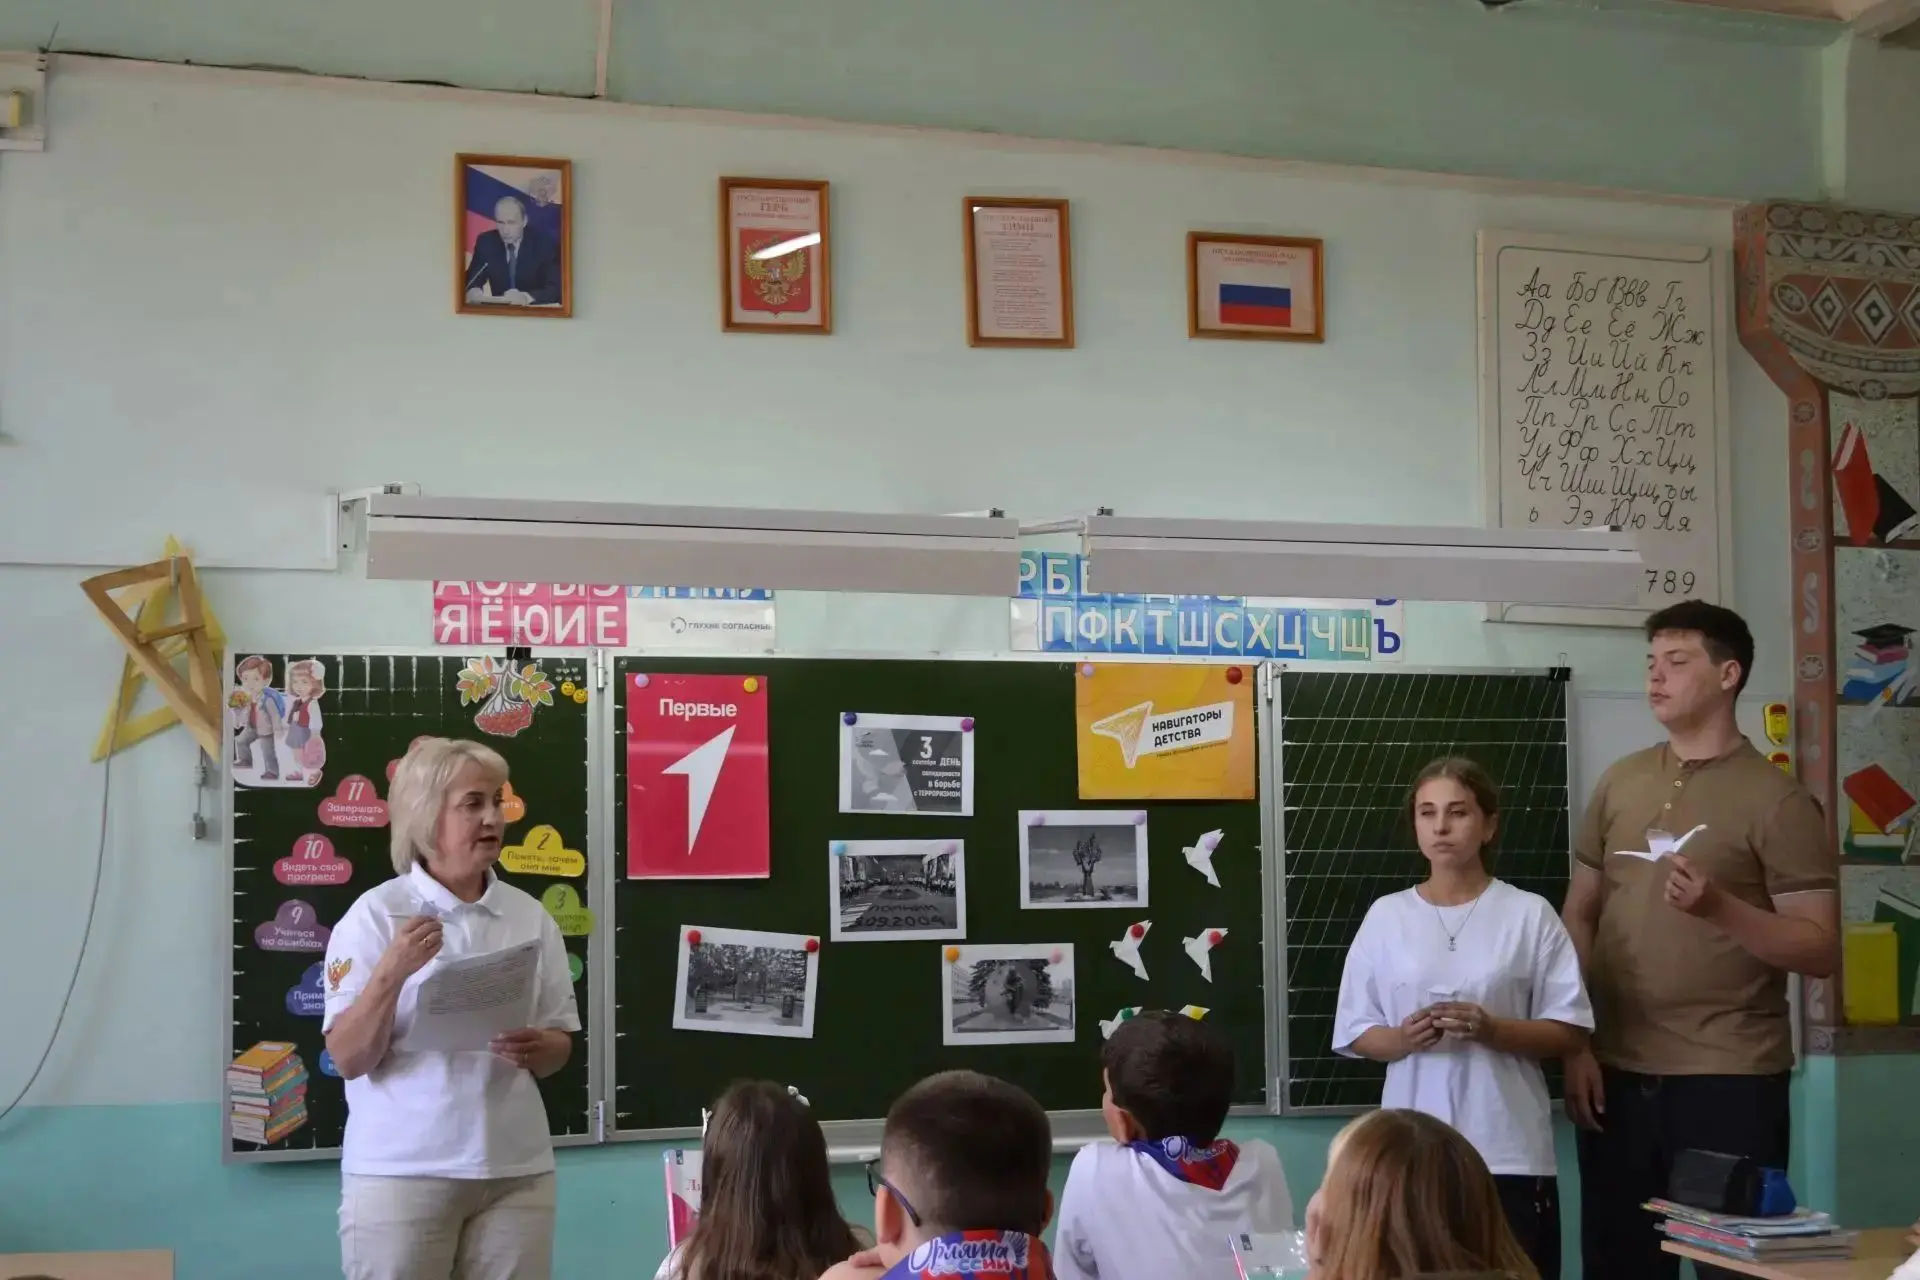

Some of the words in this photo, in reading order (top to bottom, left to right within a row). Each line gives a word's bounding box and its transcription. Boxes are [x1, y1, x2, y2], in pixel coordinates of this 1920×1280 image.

[1516, 266, 1552, 299] Аа
[1566, 271, 1608, 303] Бб
[1657, 280, 1687, 312] Гг
[1515, 298, 1556, 343] Дд
[1563, 303, 1592, 334] Ее
[1648, 310, 1705, 346] Жж
[1522, 331, 1552, 377] Зз
[1566, 336, 1605, 367] Ии
[1609, 338, 1648, 372] Йй
[1656, 344, 1694, 375] Кк
[1516, 363, 1557, 395] Лл
[1559, 367, 1606, 399] Мм
[1610, 372, 1650, 404] Нн
[1658, 376, 1690, 407] Оо
[1516, 395, 1557, 428] Пп
[1562, 397, 1599, 441] Рр
[1608, 403, 1637, 433] Сс
[1642, 404, 1696, 439] Тт
[1519, 426, 1553, 472] Уу
[1557, 429, 1600, 473] Фф
[1608, 434, 1653, 466] Хх
[1655, 436, 1698, 476] Цц
[1517, 458, 1553, 492] Чч
[1559, 462, 1606, 495] Шш
[1610, 465, 1661, 505] Щщ
[1563, 495, 1594, 526] Ээ
[1604, 498, 1646, 529] Юю
[1652, 500, 1692, 533] Яя
[1663, 570, 1677, 594] 8
[1682, 571, 1695, 595] 9
[659, 698, 737, 721] Первые
[1152, 709, 1222, 733] НАВИГАТОРЫ
[920, 736, 933, 759] 3
[1154, 727, 1202, 748] ДЕТСТВА
[939, 757, 961, 767] ДЕНЬ
[348, 782, 365, 801] 11
[918, 789, 961, 798] ТЕРРОРИЗМОМ
[928, 780, 933, 788] в
[934, 779, 961, 789] борьбе
[327, 803, 384, 814] Завершать
[332, 815, 376, 823] начатое
[304, 841, 324, 860] 10
[537, 832, 551, 851] 2
[282, 862, 318, 872] Видеть
[320, 863, 344, 872] свой
[287, 874, 336, 882] прогресс
[554, 890, 566, 910] 3
[291, 906, 303, 925] 9
[277, 938, 323, 948] ошибках
[294, 991, 326, 1002] Прим
